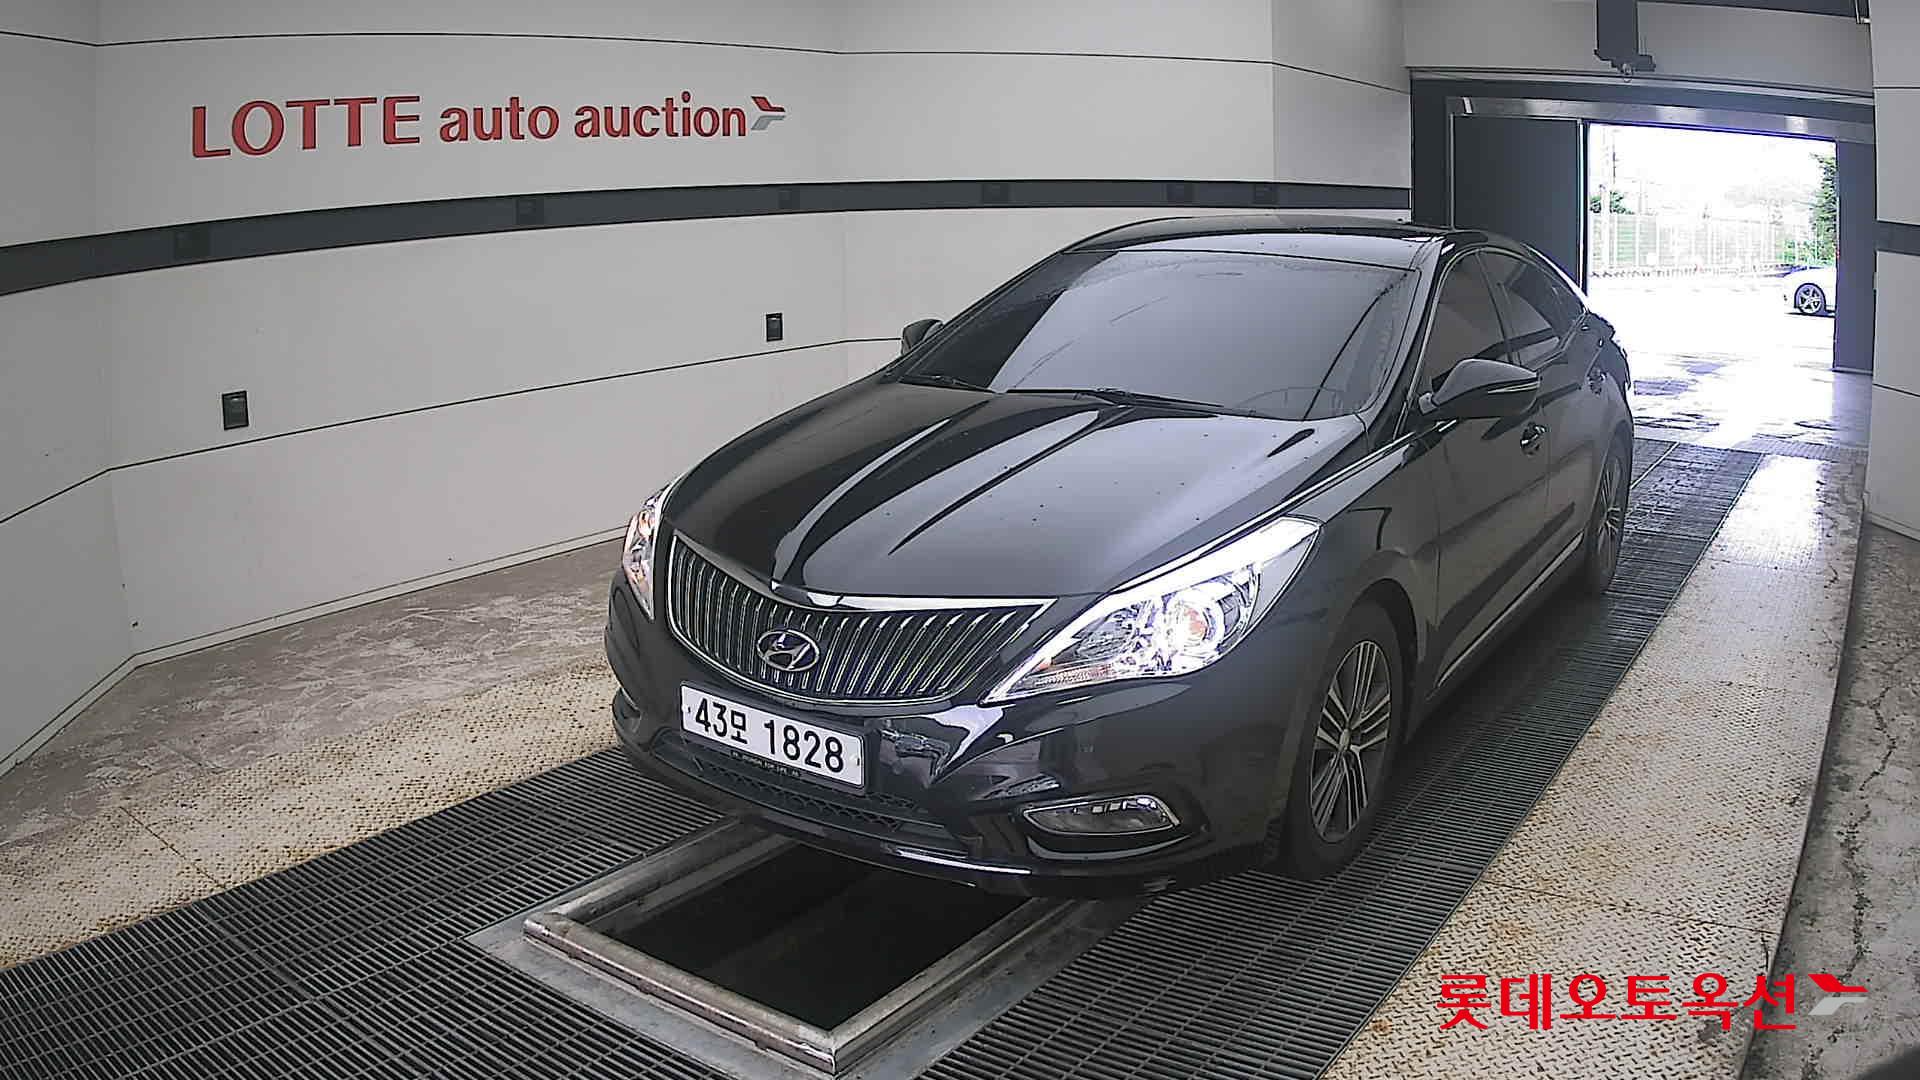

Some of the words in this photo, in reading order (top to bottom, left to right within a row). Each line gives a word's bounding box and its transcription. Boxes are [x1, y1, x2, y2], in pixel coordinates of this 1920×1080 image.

[192, 95, 421, 158] LOTTE
[439, 97, 560, 143] auto
[574, 90, 747, 138] auction
[695, 697, 748, 745] 43모
[763, 719, 844, 774] 1828
